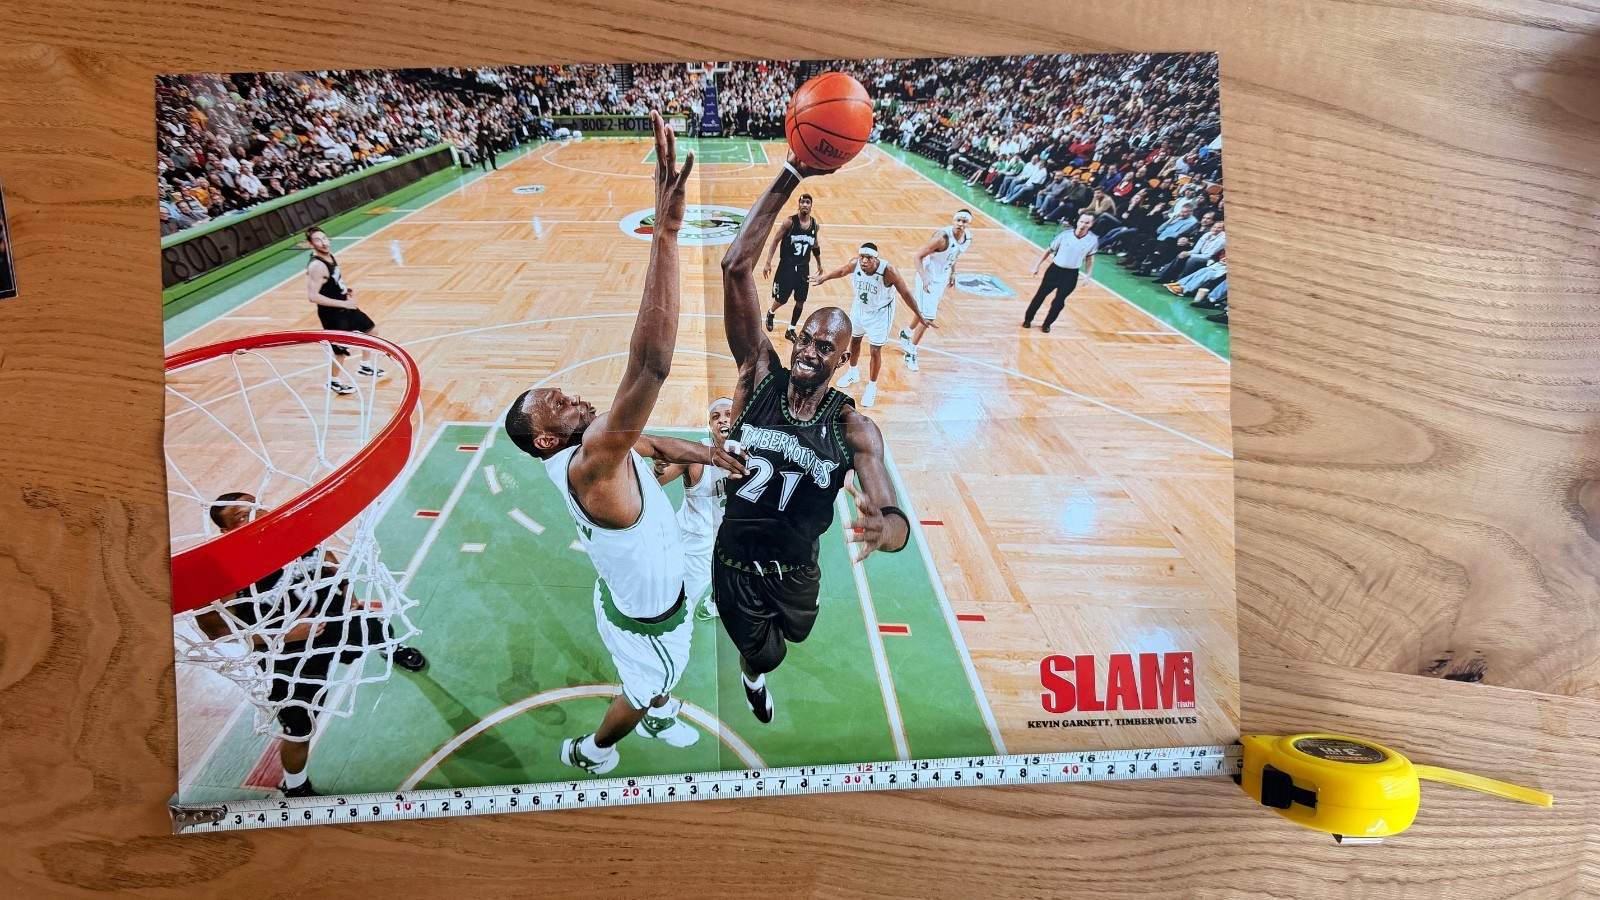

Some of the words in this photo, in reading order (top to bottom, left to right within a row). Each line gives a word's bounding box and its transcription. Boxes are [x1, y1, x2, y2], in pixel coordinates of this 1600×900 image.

[793, 242, 809, 257] 31
[859, 292, 868, 305] 4
[735, 453, 804, 512] 21
[740, 422, 840, 489] TIMBERWOLVES
[1039, 651, 1196, 714] SLAM
[1027, 720, 1060, 729] KEVIN
[1062, 718, 1113, 728] GARNETT,
[1114, 716, 1198, 727] TIMBERWOLVES
[234, 814, 242, 825] 3
[257, 813, 265, 823] 4
[281, 812, 288, 821] 5
[304, 810, 311, 820] 6
[327, 809, 334, 818] 7
[349, 808, 358, 817] 8
[372, 806, 380, 816] 9
[395, 802, 411, 811] 10
[420, 803, 425, 812] 1
[441, 802, 449, 811] 2
[464, 800, 472, 810] 3
[510, 797, 518, 806] 5
[532, 796, 540, 805] 6
[555, 794, 562, 804] 7
[578, 792, 585, 802] 8
[600, 791, 607, 800] 9
[622, 788, 640, 797] 20
[647, 788, 652, 797] 1
[667, 787, 675, 796] 2
[690, 785, 697, 795] 3
[712, 784, 719, 793] 4
[778, 780, 785, 789] 7
[844, 775, 861, 784] 30
[868, 775, 874, 784] 1
[889, 774, 897, 783] 2
[910, 773, 918, 782] 3
[932, 772, 939, 781] 4
[954, 771, 962, 780] 5
[976, 771, 983, 780] 6
[998, 769, 1005, 779] 7
[1019, 768, 1027, 778] 8
[1062, 765, 1079, 774] 40
[1087, 767, 1092, 775] 1
[1107, 765, 1114, 774] 2
[1129, 764, 1136, 774] 3
[1150, 763, 1158, 772] 4
[278, 801, 288, 809] 2
[395, 794, 404, 802] 4
[454, 790, 463, 798] 5
[627, 779, 636, 787] 8
[684, 775, 693, 783] 9
[743, 771, 761, 779] 10
[800, 767, 816, 776] 11
[856, 764, 873, 772] 12
[912, 762, 929, 770] 13
[967, 759, 984, 767] 14
[1023, 756, 1040, 765] 15
[1079, 754, 1096, 763] 16
[1135, 752, 1151, 760] 17
